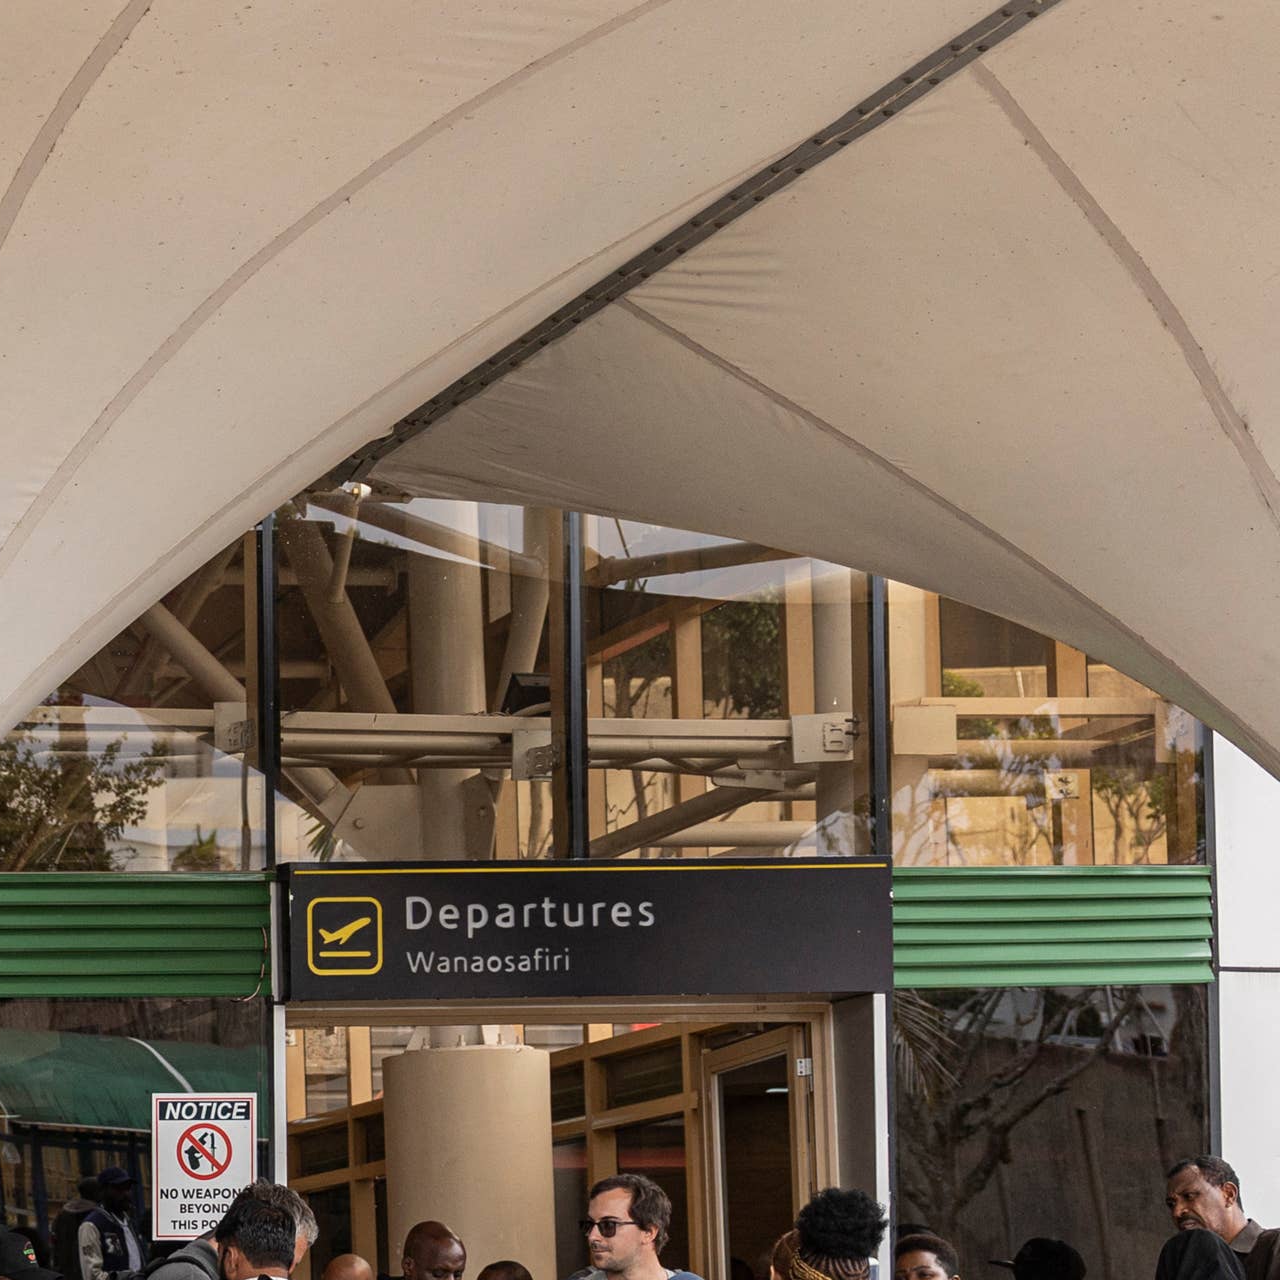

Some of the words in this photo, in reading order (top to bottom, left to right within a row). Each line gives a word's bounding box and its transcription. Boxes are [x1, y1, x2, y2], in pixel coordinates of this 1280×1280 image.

[405, 895, 656, 939] Departures
[406, 947, 570, 974] Wanaosafiri
[164, 1102, 248, 1120] NOTICE
[160, 1188, 179, 1199] NO
[181, 1188, 242, 1199] WEAPON
[179, 1203, 230, 1214] BEYOND
[171, 1219, 199, 1230] THIS
